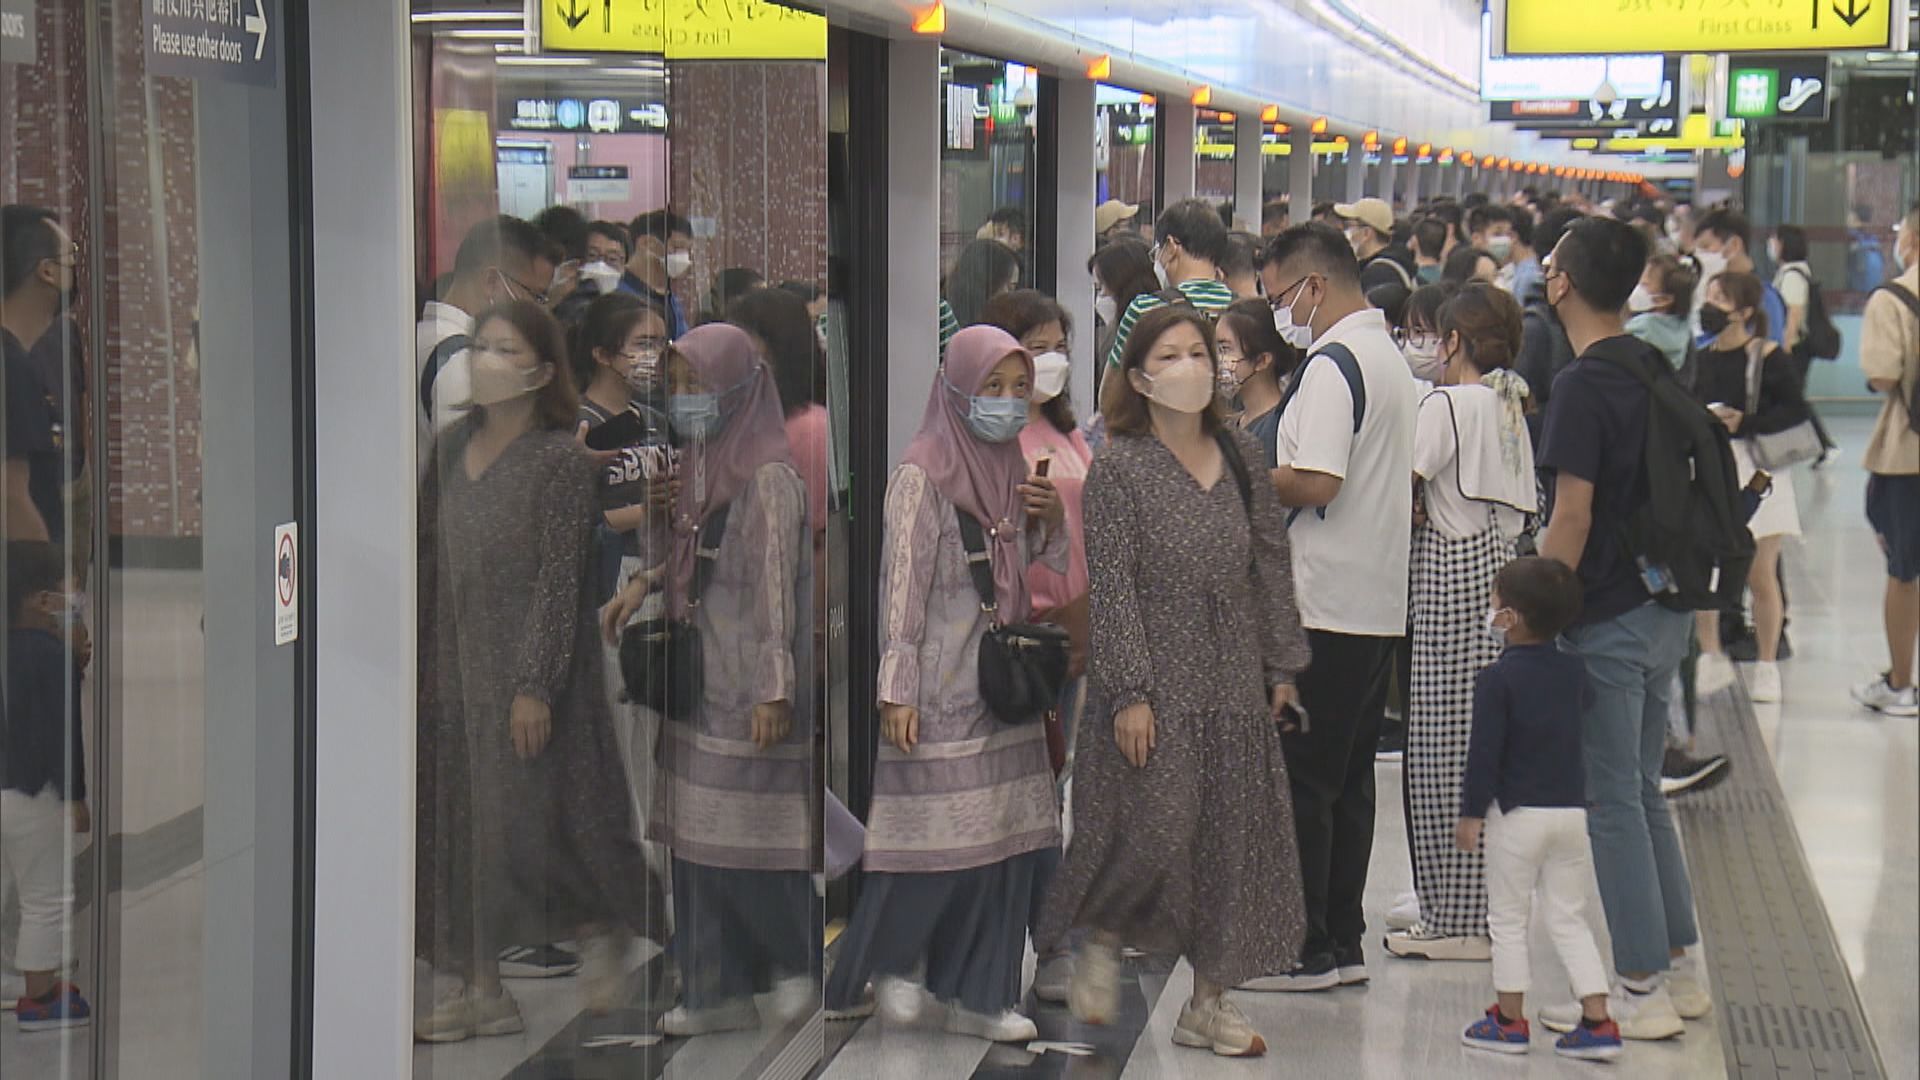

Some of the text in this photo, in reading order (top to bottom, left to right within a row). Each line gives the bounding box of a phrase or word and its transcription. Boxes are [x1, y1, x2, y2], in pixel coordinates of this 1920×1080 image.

[1699, 17, 1793, 34] First Class
[152, 24, 242, 64] Please use other doors
